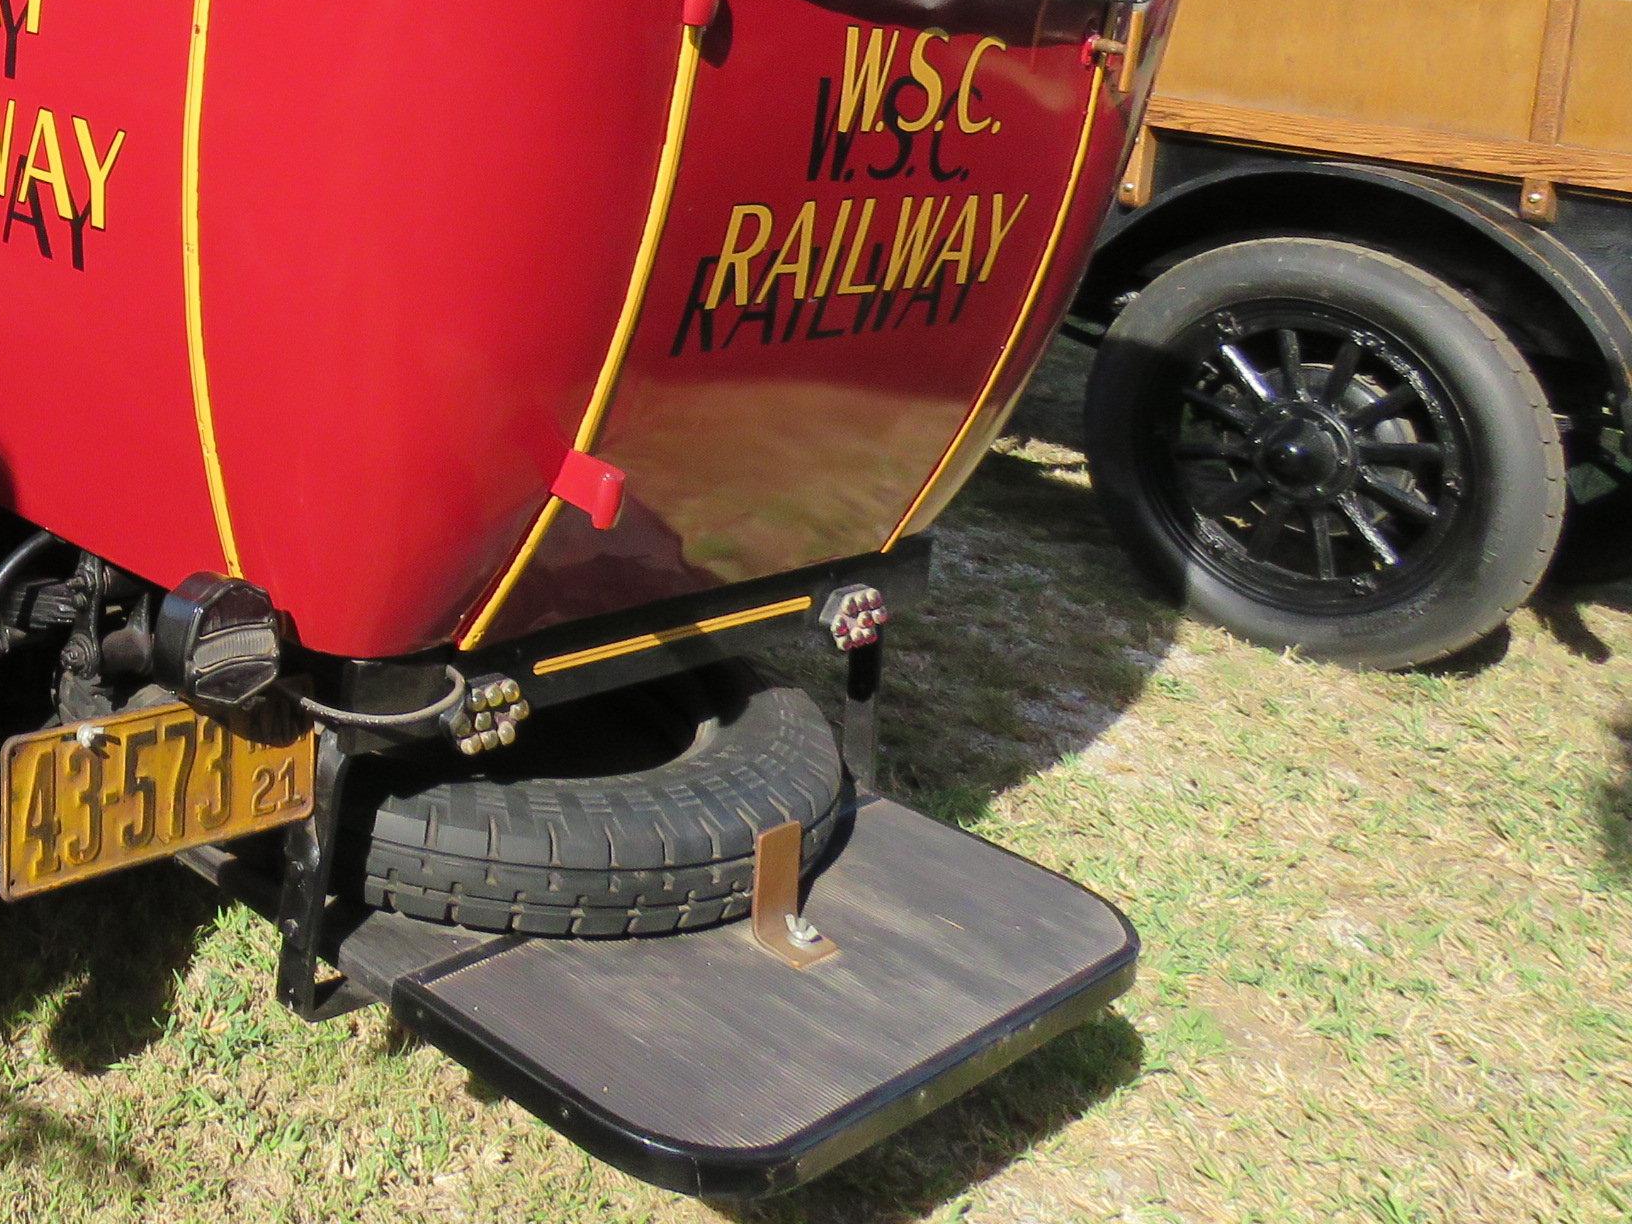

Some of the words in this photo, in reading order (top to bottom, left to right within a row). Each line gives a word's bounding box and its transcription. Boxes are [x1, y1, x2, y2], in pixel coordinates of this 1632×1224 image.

[837, 25, 1008, 135] W.S.C.
[703, 192, 1030, 311] RAILWAY
[23, 717, 233, 881] 43-573
[252, 756, 303, 816] 21
